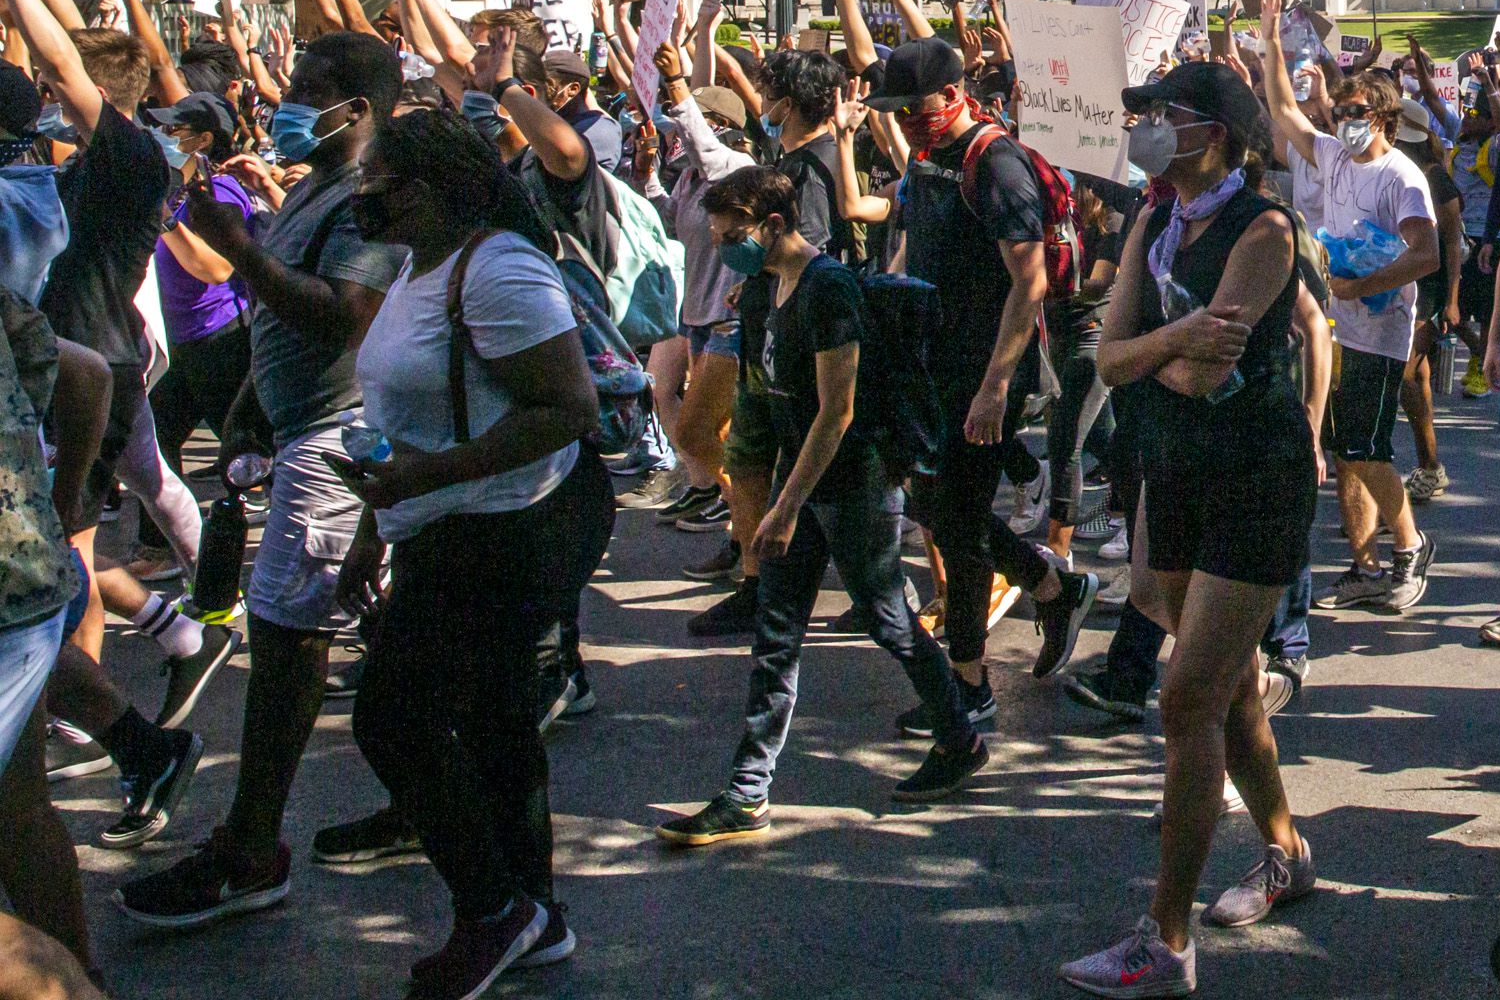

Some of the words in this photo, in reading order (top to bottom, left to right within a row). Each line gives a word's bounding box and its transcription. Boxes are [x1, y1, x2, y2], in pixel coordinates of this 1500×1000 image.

[868, 16, 902, 25] PENC
[1438, 86, 1457, 101] ACE
[1019, 80, 1050, 112] Black
[1049, 88, 1072, 112] Lives
[1075, 94, 1114, 126] Matter
